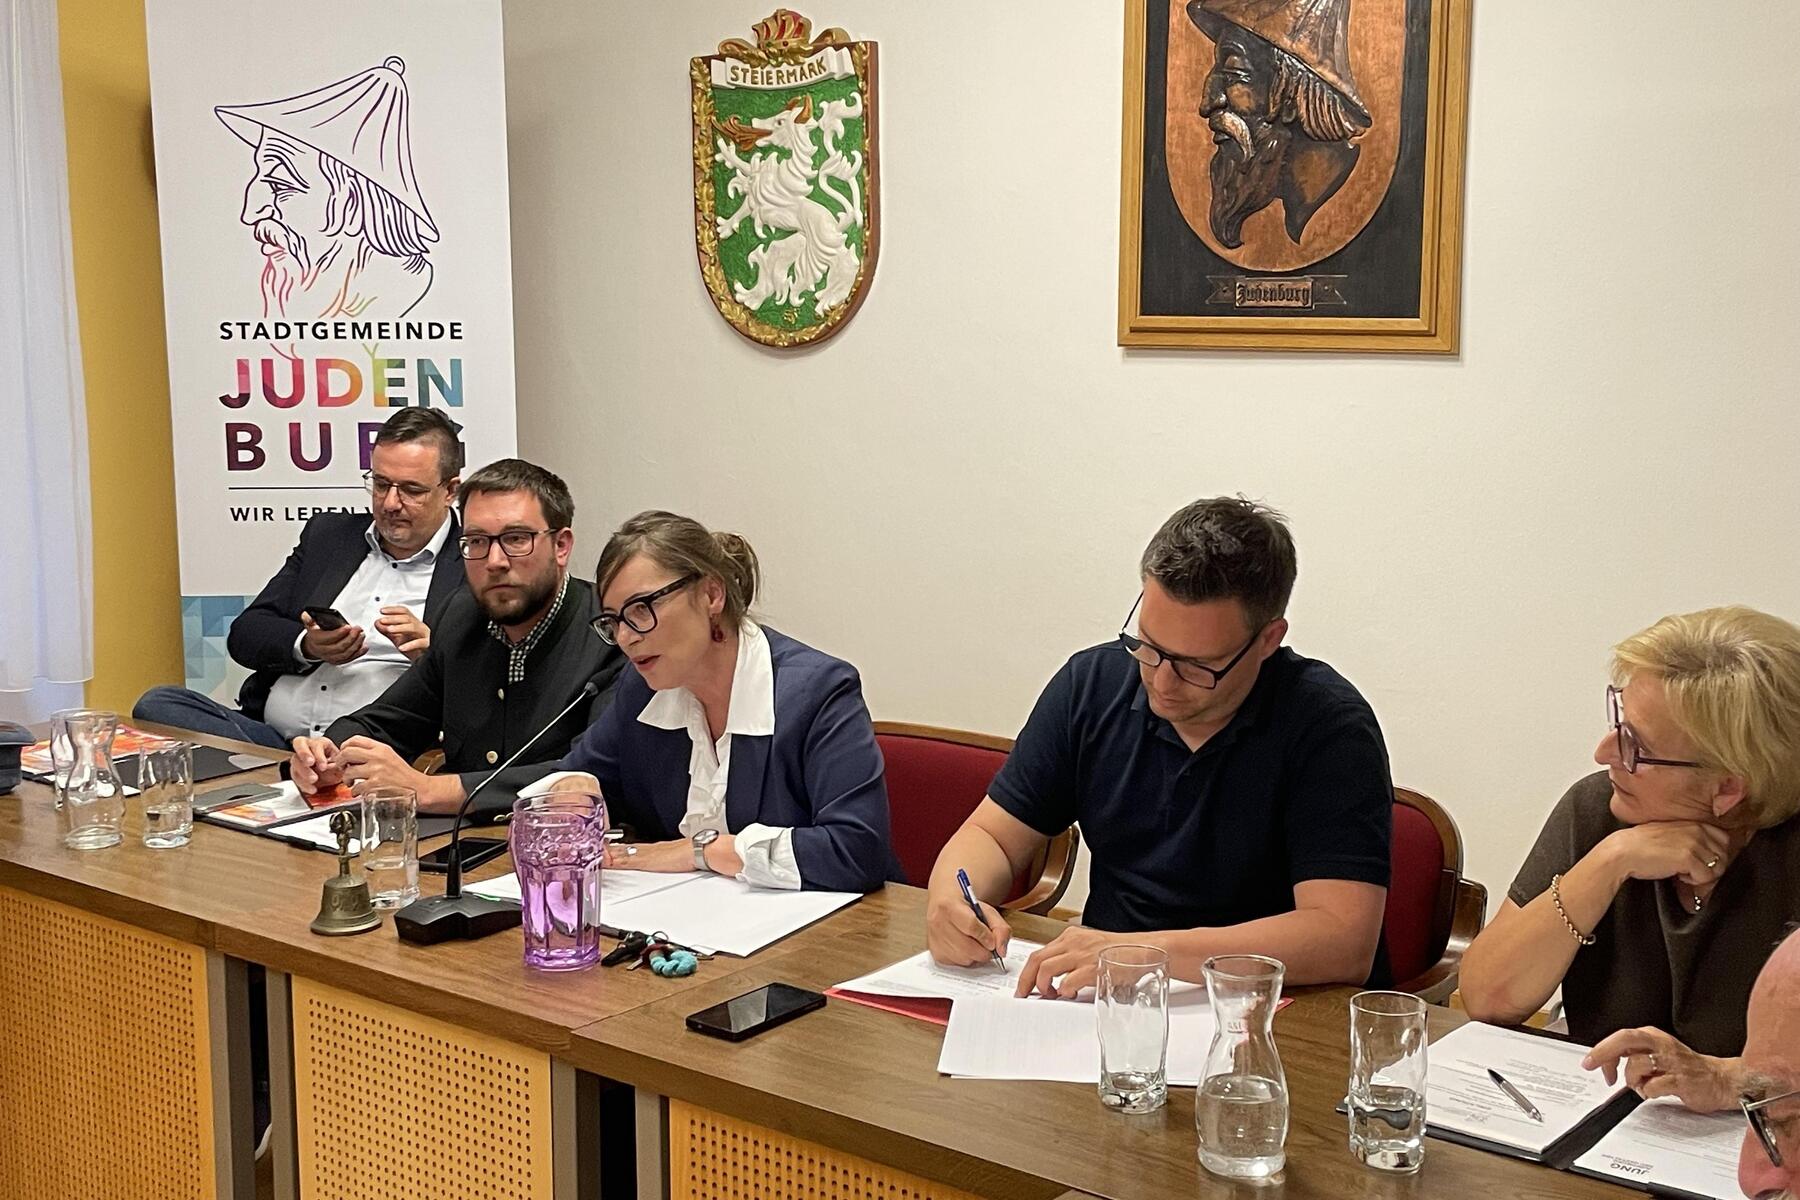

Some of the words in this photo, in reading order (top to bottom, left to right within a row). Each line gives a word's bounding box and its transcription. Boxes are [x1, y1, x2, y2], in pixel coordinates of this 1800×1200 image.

[730, 57, 827, 86] STEIERMARK
[1237, 283, 1310, 306] Judenburg
[219, 321, 463, 340] STADTGEMEINDE
[218, 358, 464, 409] JUDEN
[225, 422, 466, 472] BU
[230, 507, 275, 522] WIR
